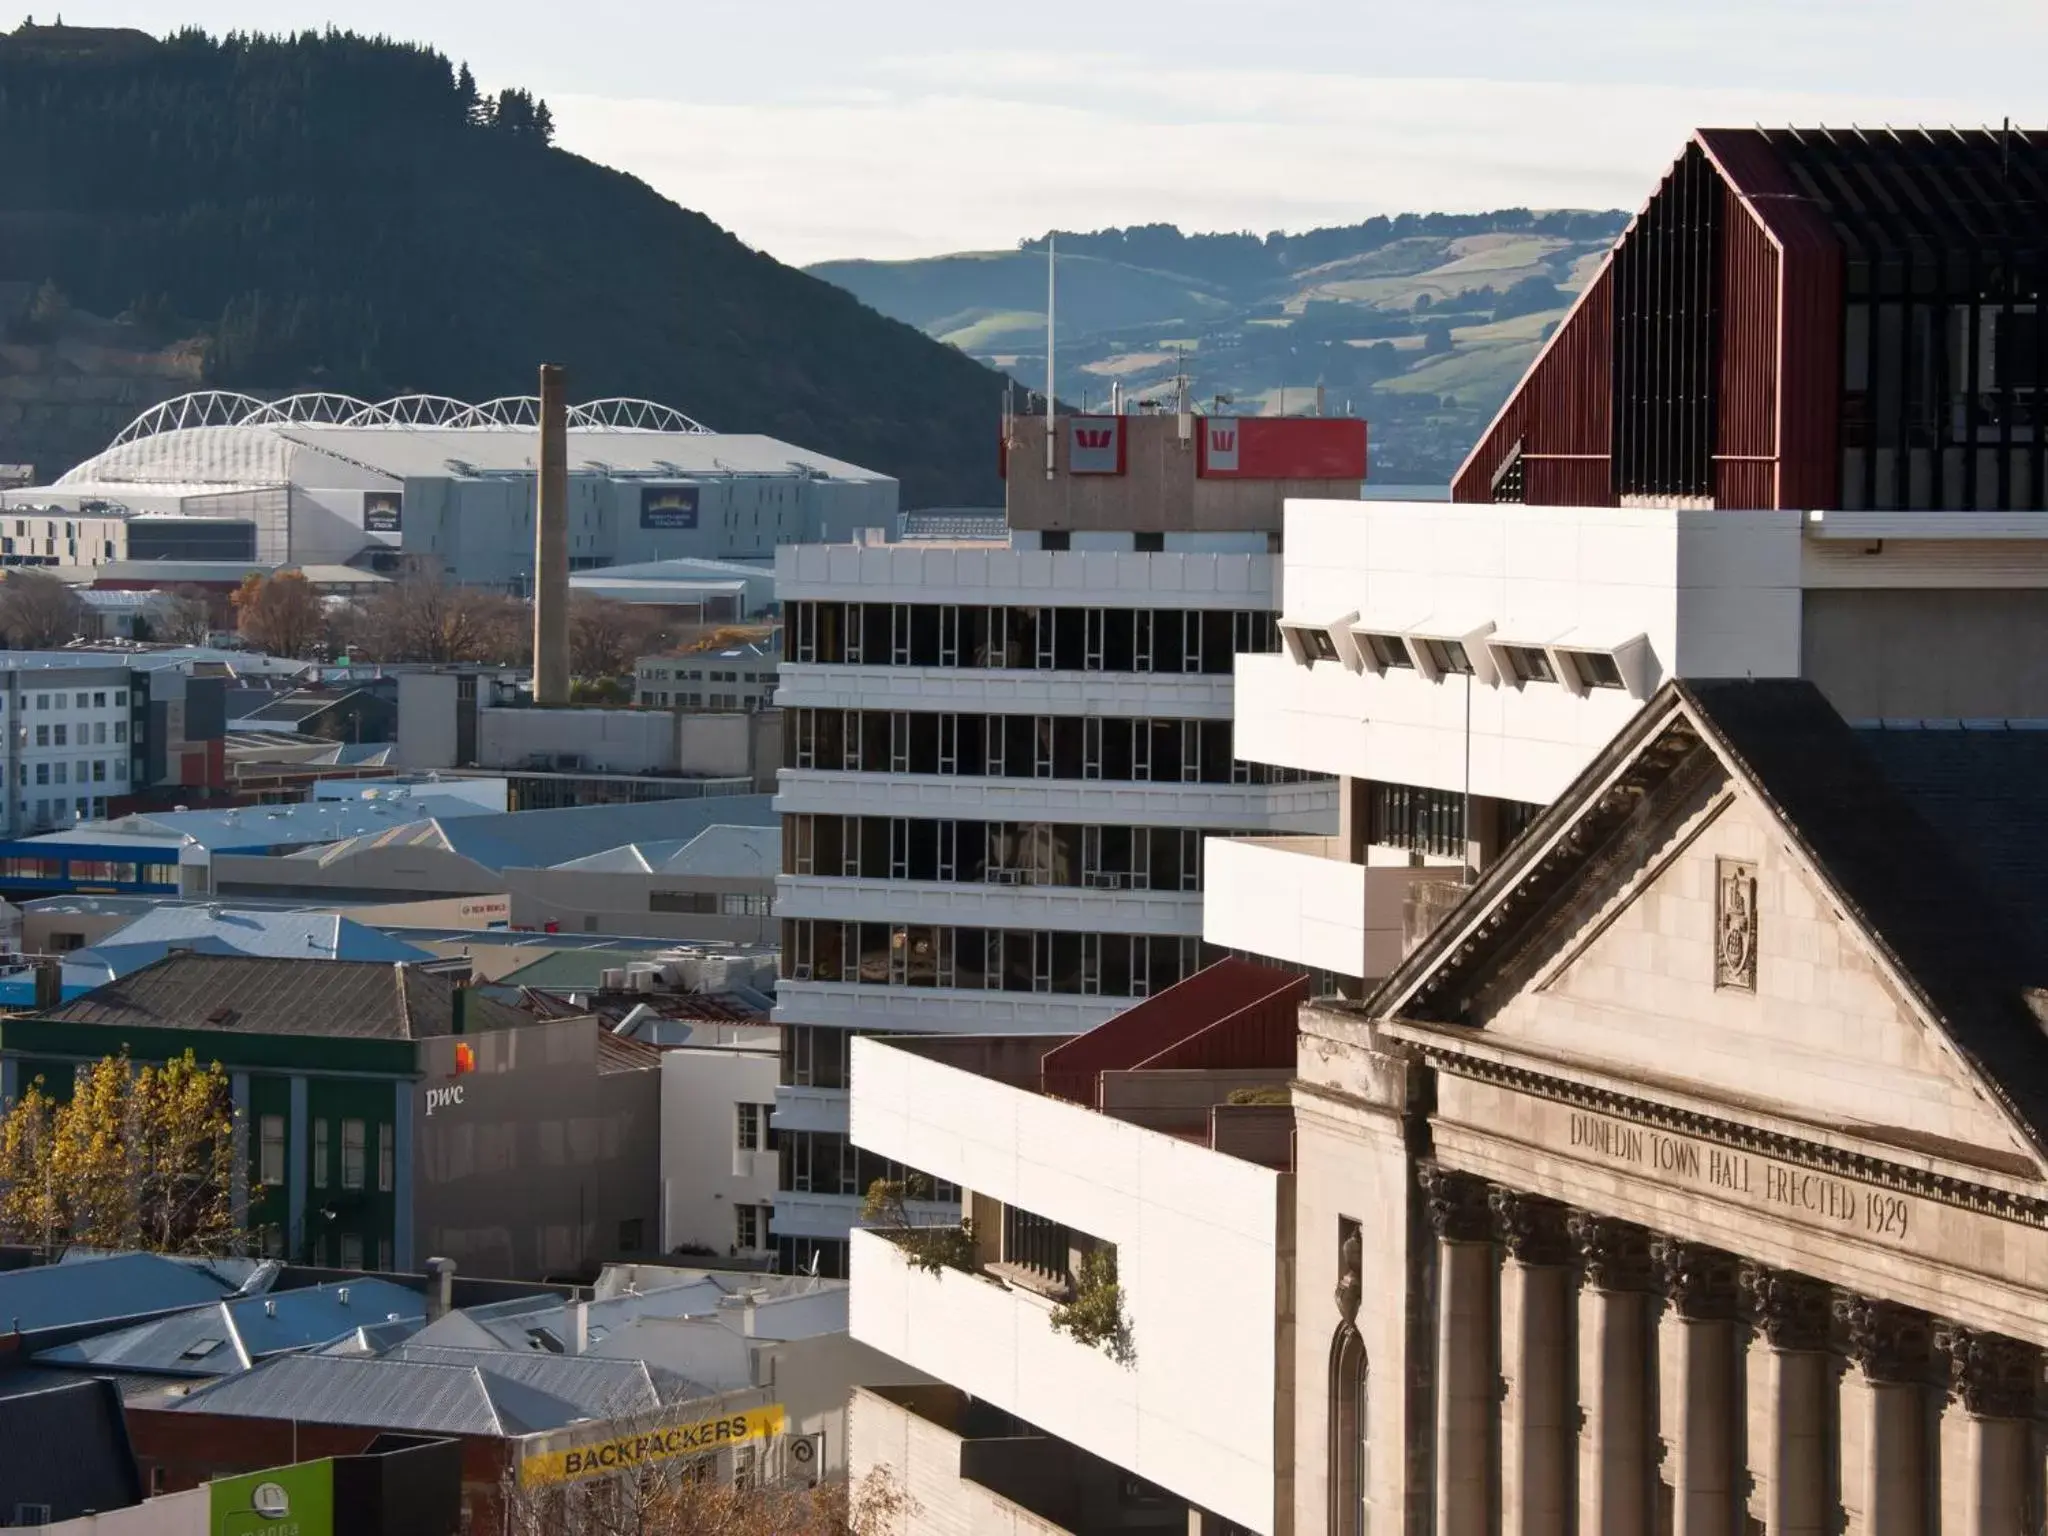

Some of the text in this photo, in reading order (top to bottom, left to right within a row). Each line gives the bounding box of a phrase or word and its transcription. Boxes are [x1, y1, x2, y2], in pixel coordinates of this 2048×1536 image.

[426, 1085, 465, 1116] pwc
[1570, 1112, 1908, 1240] DUNEDIN TOWN HALL ERECTED 1929
[565, 1415, 748, 1474] BACKPACKERS
